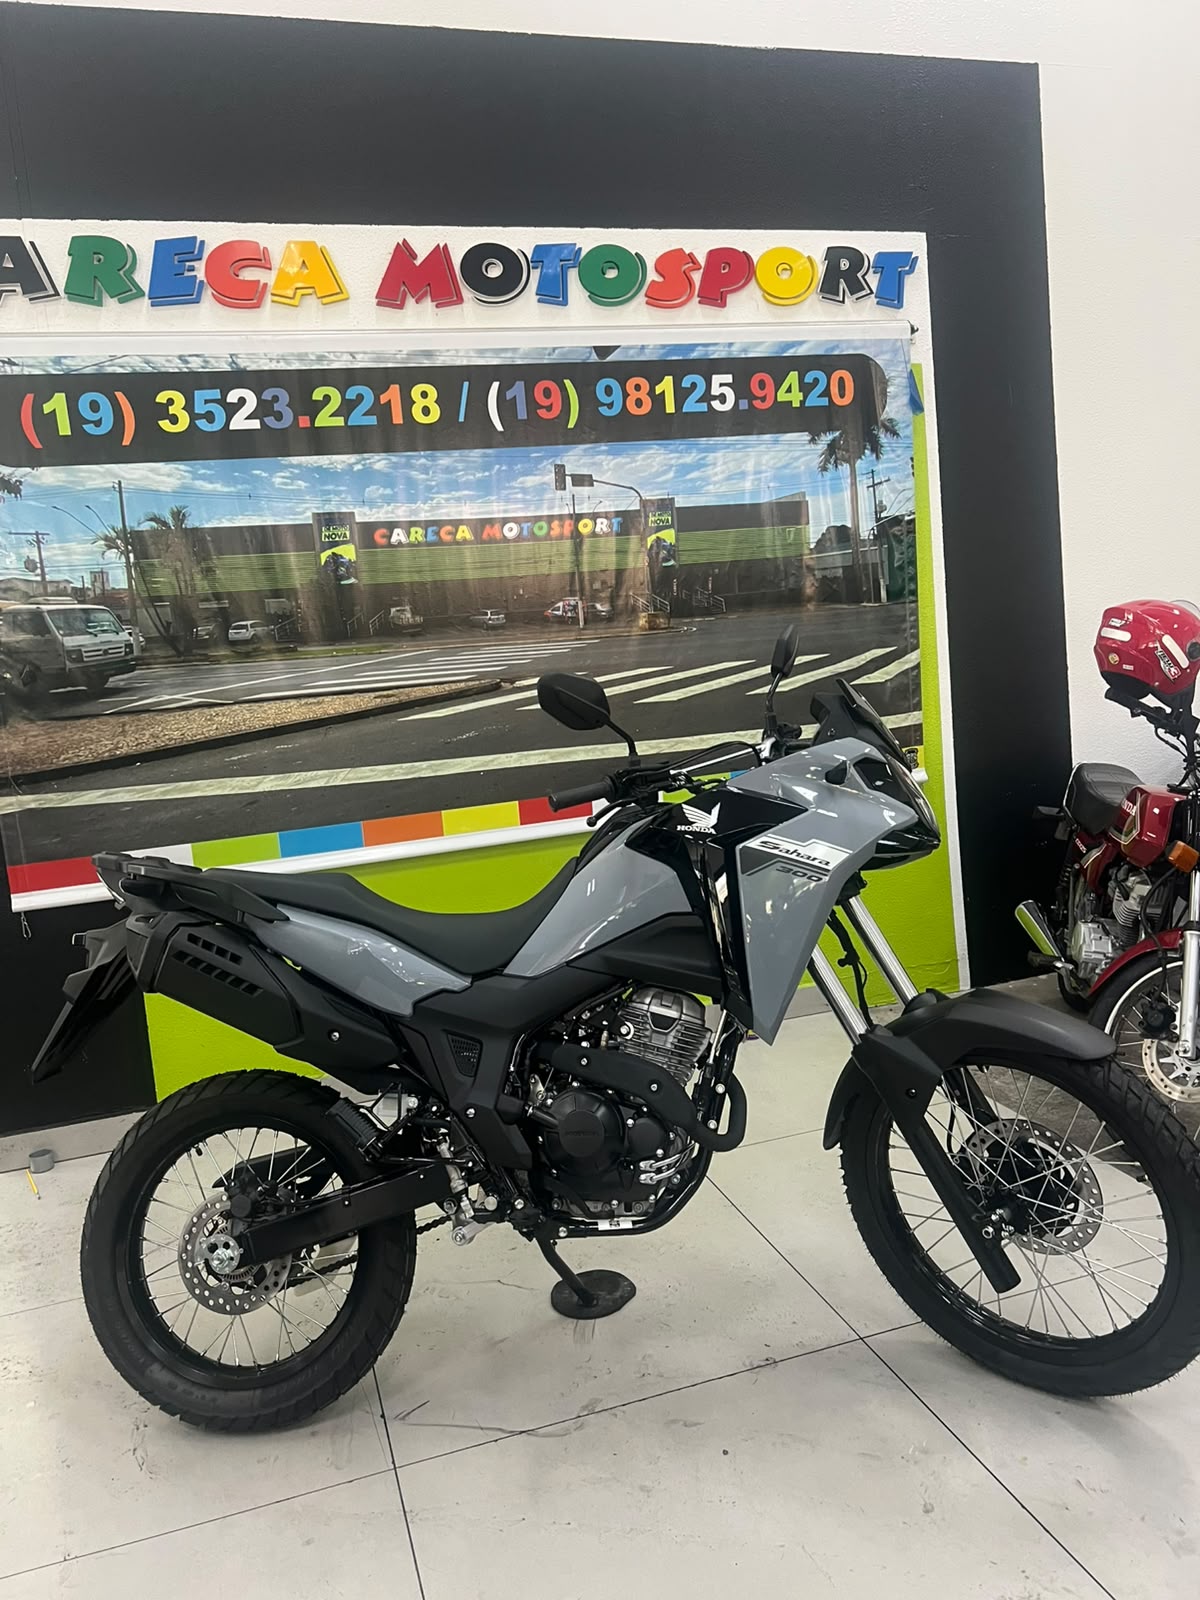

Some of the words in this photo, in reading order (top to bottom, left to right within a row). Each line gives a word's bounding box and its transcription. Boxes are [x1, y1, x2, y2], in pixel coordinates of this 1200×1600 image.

[375, 238, 919, 310] MOTOSPORT
[20, 391, 136, 449] (19)
[155, 383, 442, 433] 3523.2218
[487, 378, 580, 432] (19)
[595, 369, 854, 417] 98125.9420
[373, 525, 474, 545] CARECA
[481, 517, 624, 540] MOTOSPORT
[650, 518, 669, 526] NOVA
[323, 532, 348, 540] NOVA
[676, 824, 717, 835] HONDA
[758, 839, 832, 867] Sahara
[775, 865, 824, 883] 300
